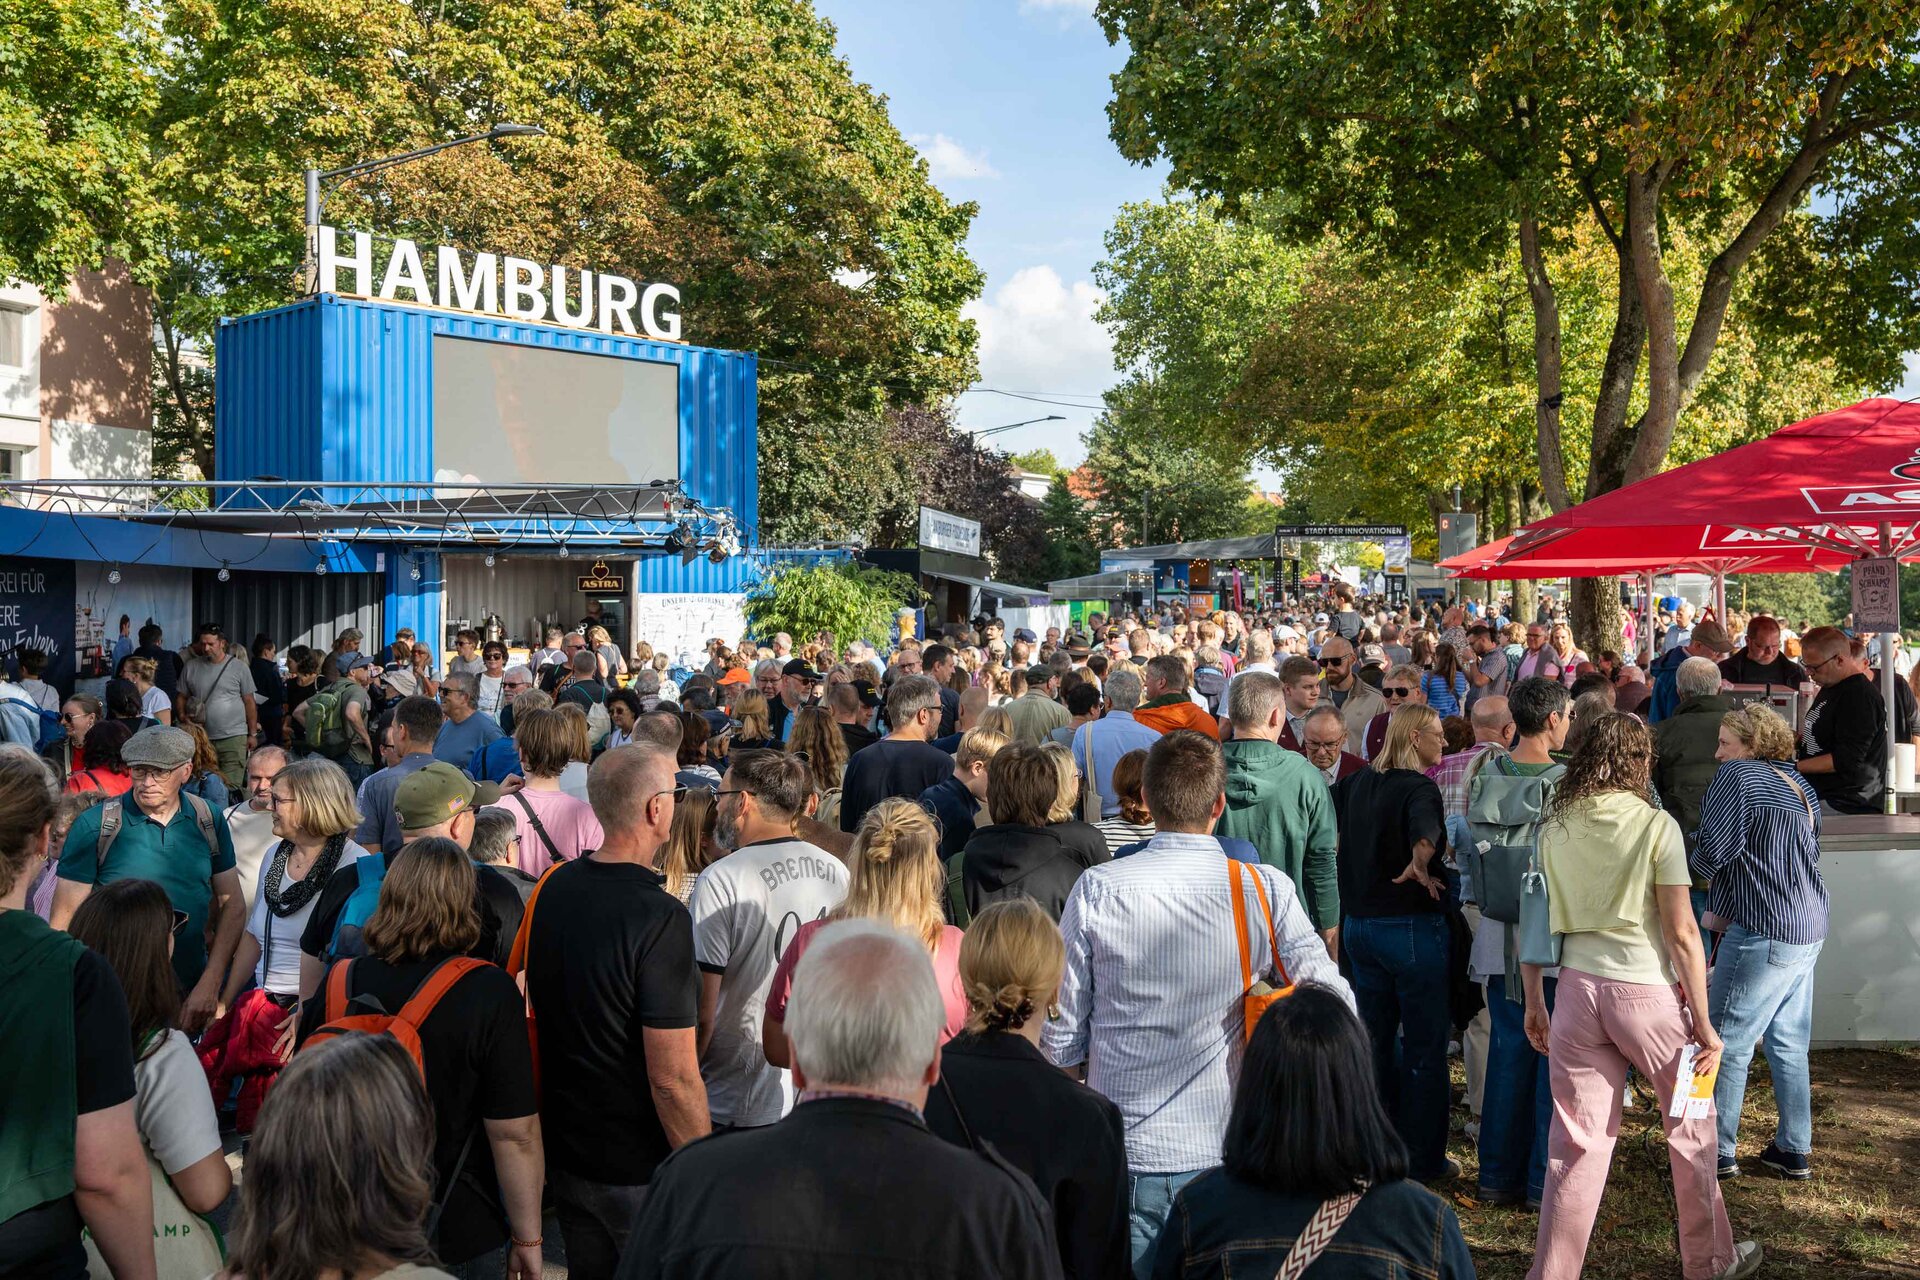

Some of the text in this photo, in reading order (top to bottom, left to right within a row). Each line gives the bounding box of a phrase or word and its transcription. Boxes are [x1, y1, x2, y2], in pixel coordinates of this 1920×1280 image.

[319, 225, 681, 340] HAMBURG
[1304, 527, 1402, 535] STADT DER INNOVATIONEN
[1863, 565, 1885, 577] PFAND
[21, 567, 45, 593] FÜR
[582, 580, 619, 588] ASTRA
[661, 597, 687, 608] UNSERE
[760, 856, 836, 892] BREMEN
